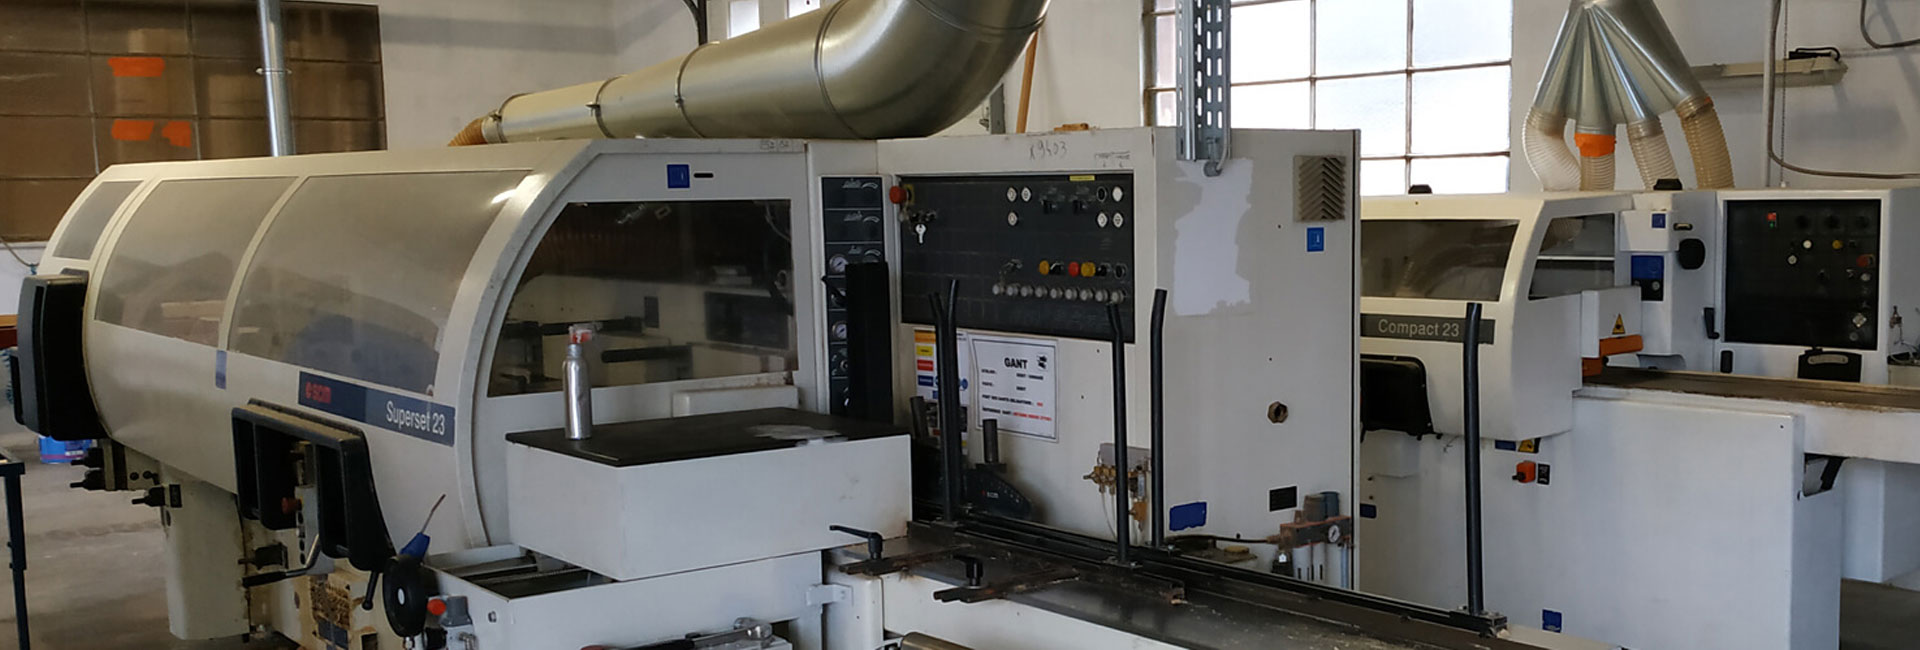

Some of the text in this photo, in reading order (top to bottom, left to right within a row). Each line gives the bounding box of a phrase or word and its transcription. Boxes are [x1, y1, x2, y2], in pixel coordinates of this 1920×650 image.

[1378, 319, 1460, 338] Compact 23
[1004, 357, 1028, 369] GANT
[386, 400, 446, 436] Superset 23
